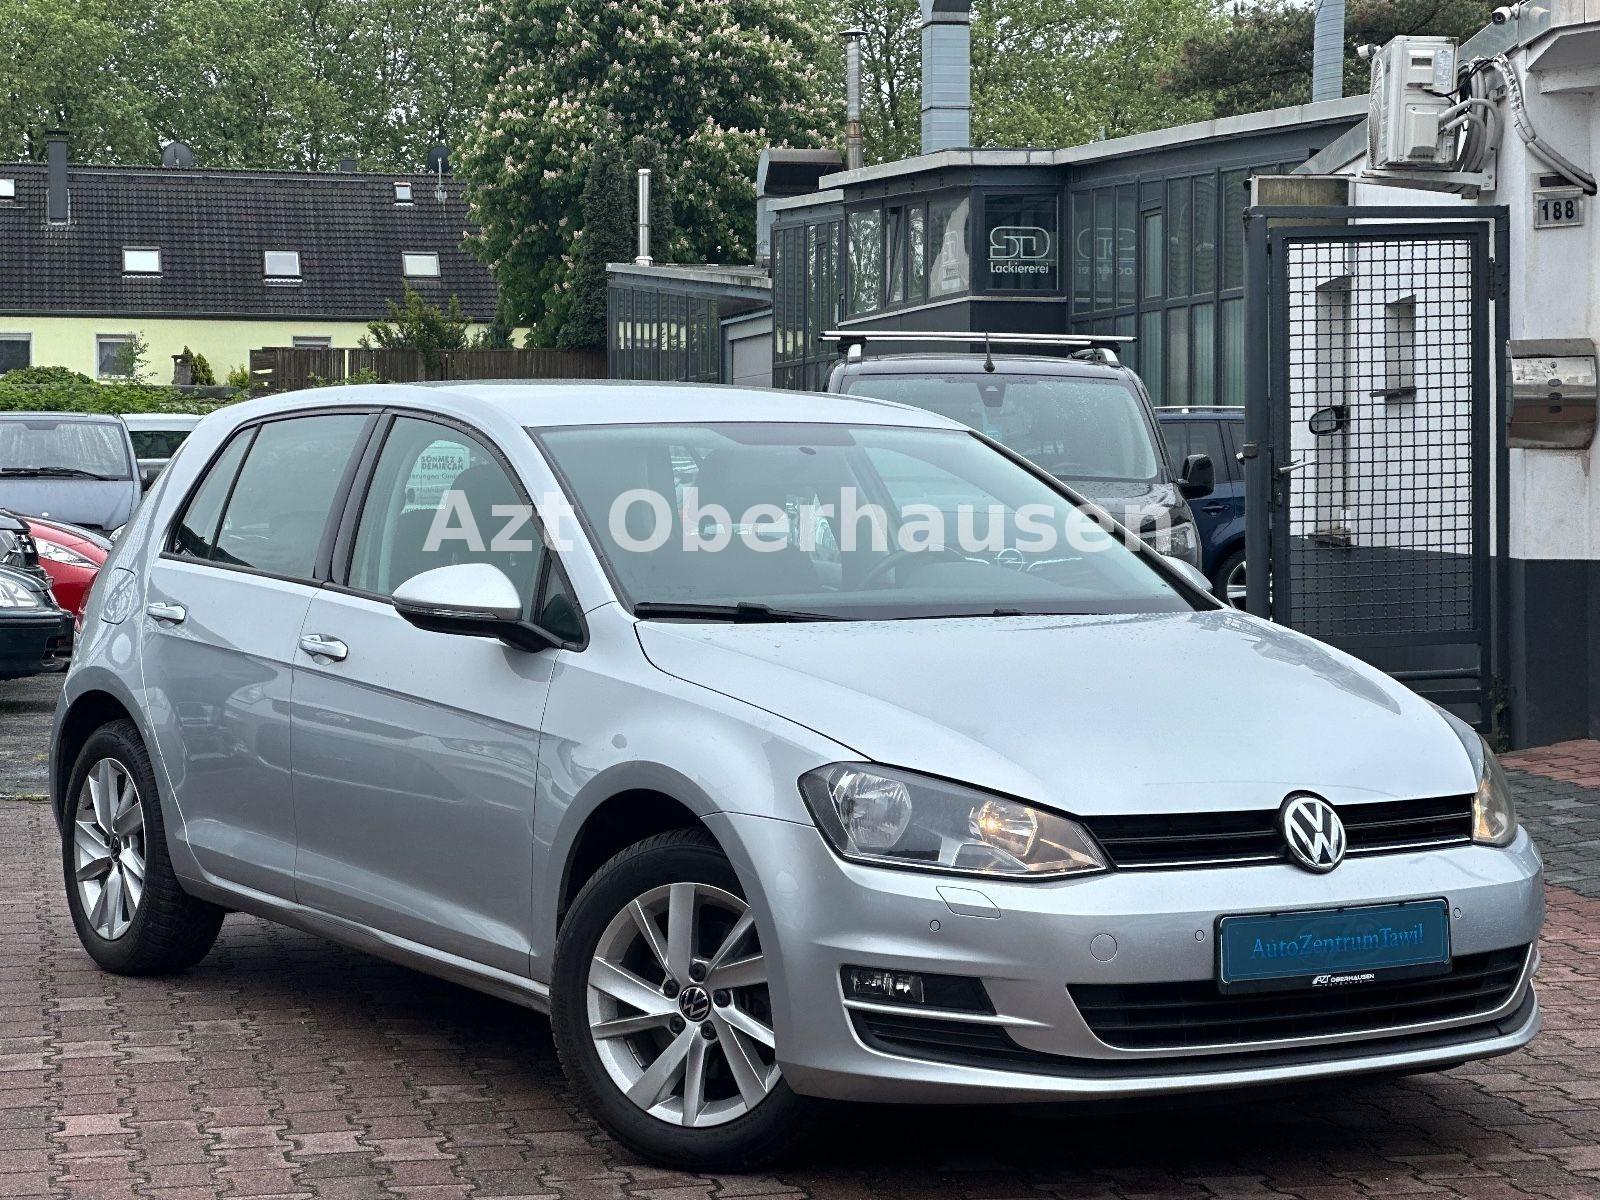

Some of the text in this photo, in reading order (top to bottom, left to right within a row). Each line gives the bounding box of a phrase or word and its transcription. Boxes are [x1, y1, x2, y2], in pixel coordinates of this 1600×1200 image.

[1542, 200, 1575, 220] 188
[989, 226, 1050, 259] SD
[990, 261, 1049, 274] Lackiererei
[1285, 797, 1345, 867] VW
[1250, 923, 1424, 960] AutoZentrumTawil
[1331, 973, 1375, 983] OBERHAUSEN
